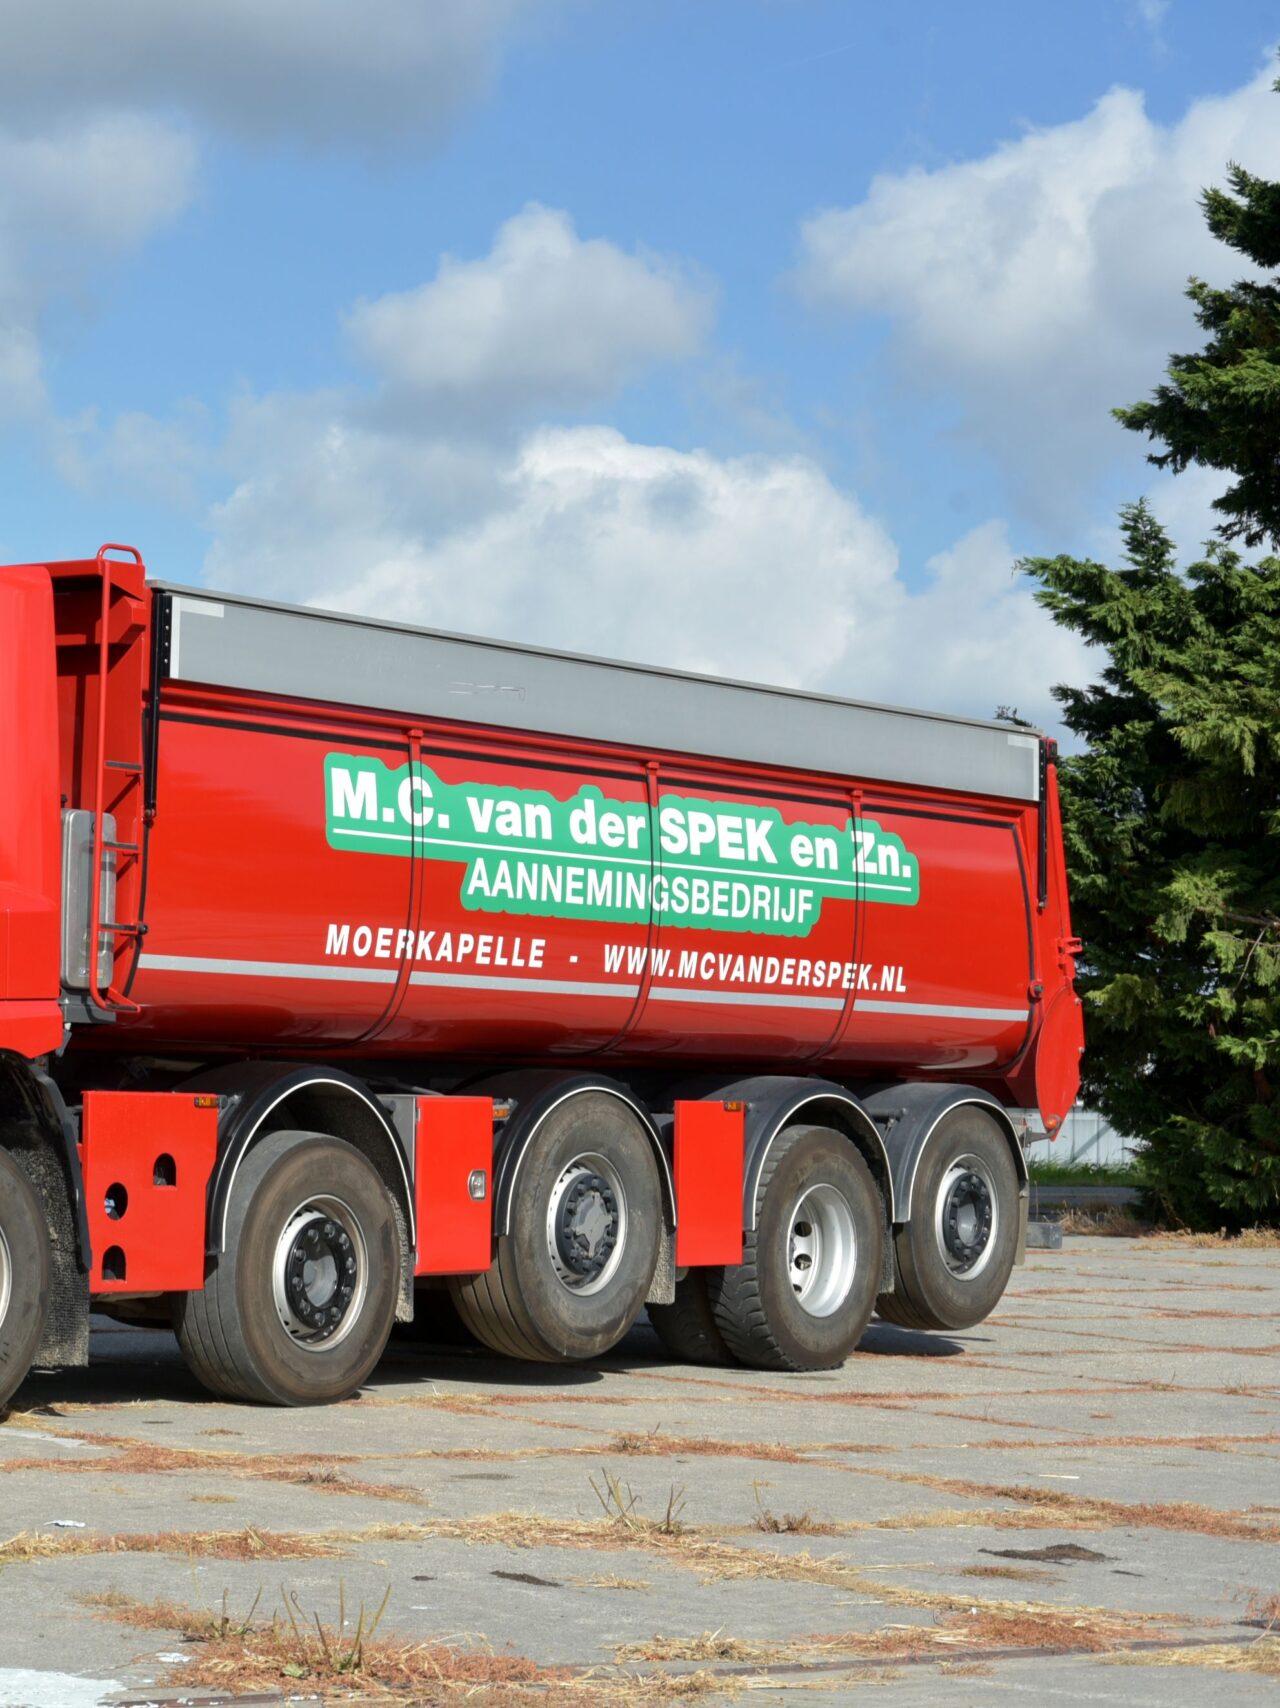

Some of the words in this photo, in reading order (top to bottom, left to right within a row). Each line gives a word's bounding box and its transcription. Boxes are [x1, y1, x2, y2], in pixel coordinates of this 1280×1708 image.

[331, 767, 450, 829] M.C.
[466, 796, 552, 840] van
[569, 798, 646, 849] der
[659, 807, 778, 864] SPEK
[790, 833, 839, 870] en
[851, 830, 912, 878] Zn.
[467, 857, 814, 924] AANNEMINGSBEDRIJF
[325, 923, 546, 968] MOERKAPELLE
[604, 944, 907, 993] WWW.MCVANDERSPEK.NL
